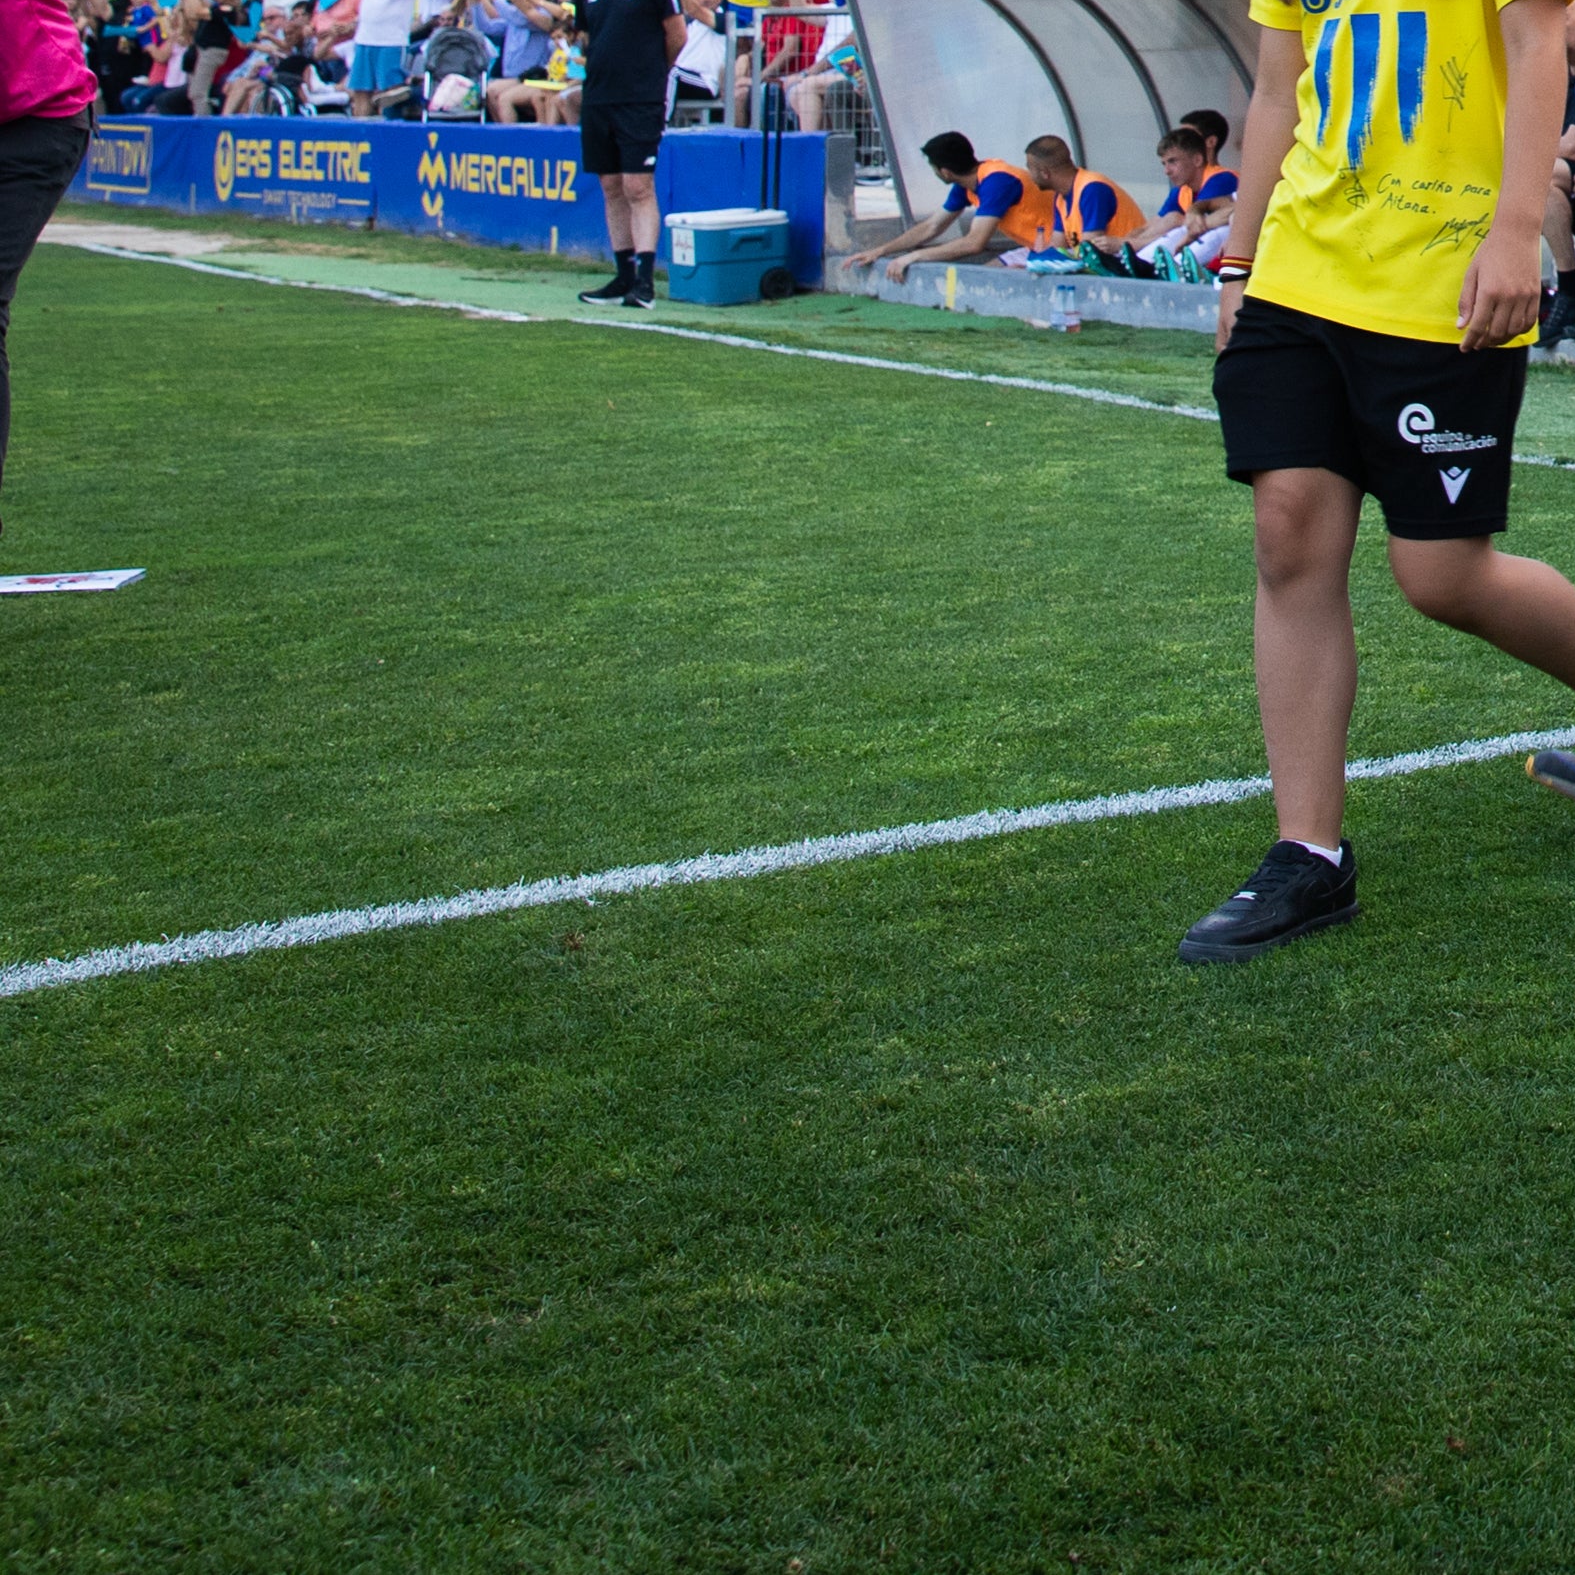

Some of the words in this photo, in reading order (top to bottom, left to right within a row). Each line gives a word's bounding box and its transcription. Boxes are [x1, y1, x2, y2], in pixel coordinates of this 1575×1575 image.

[278, 139, 371, 183] ELECTRIC
[451, 152, 577, 202] MERCALUZ
[1377, 173, 1401, 193] Con
[1460, 183, 1491, 196] para
